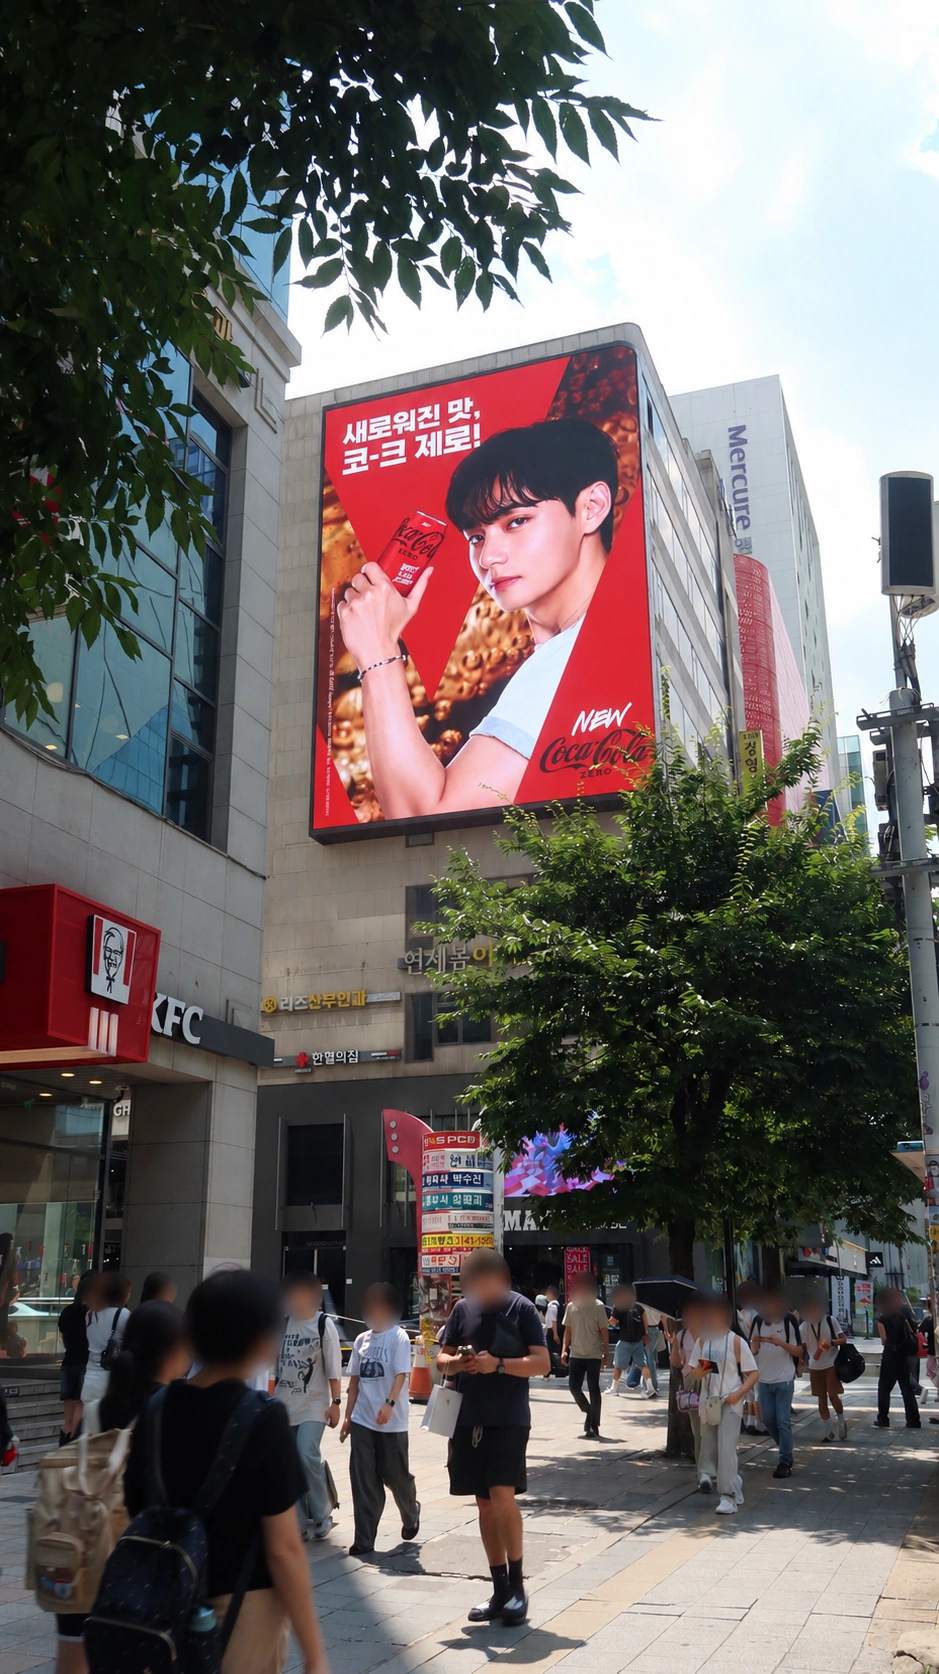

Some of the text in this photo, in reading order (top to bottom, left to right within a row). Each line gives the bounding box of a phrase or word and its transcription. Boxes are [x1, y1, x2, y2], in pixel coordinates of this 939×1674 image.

[342, 397, 481, 445] 새로워진 맛,
[342, 423, 481, 475] 코-크 제로!
[727, 424, 751, 531] Mercure
[571, 701, 633, 737] NEW
[580, 767, 612, 779] ZERO
[151, 992, 204, 1045] KFC
